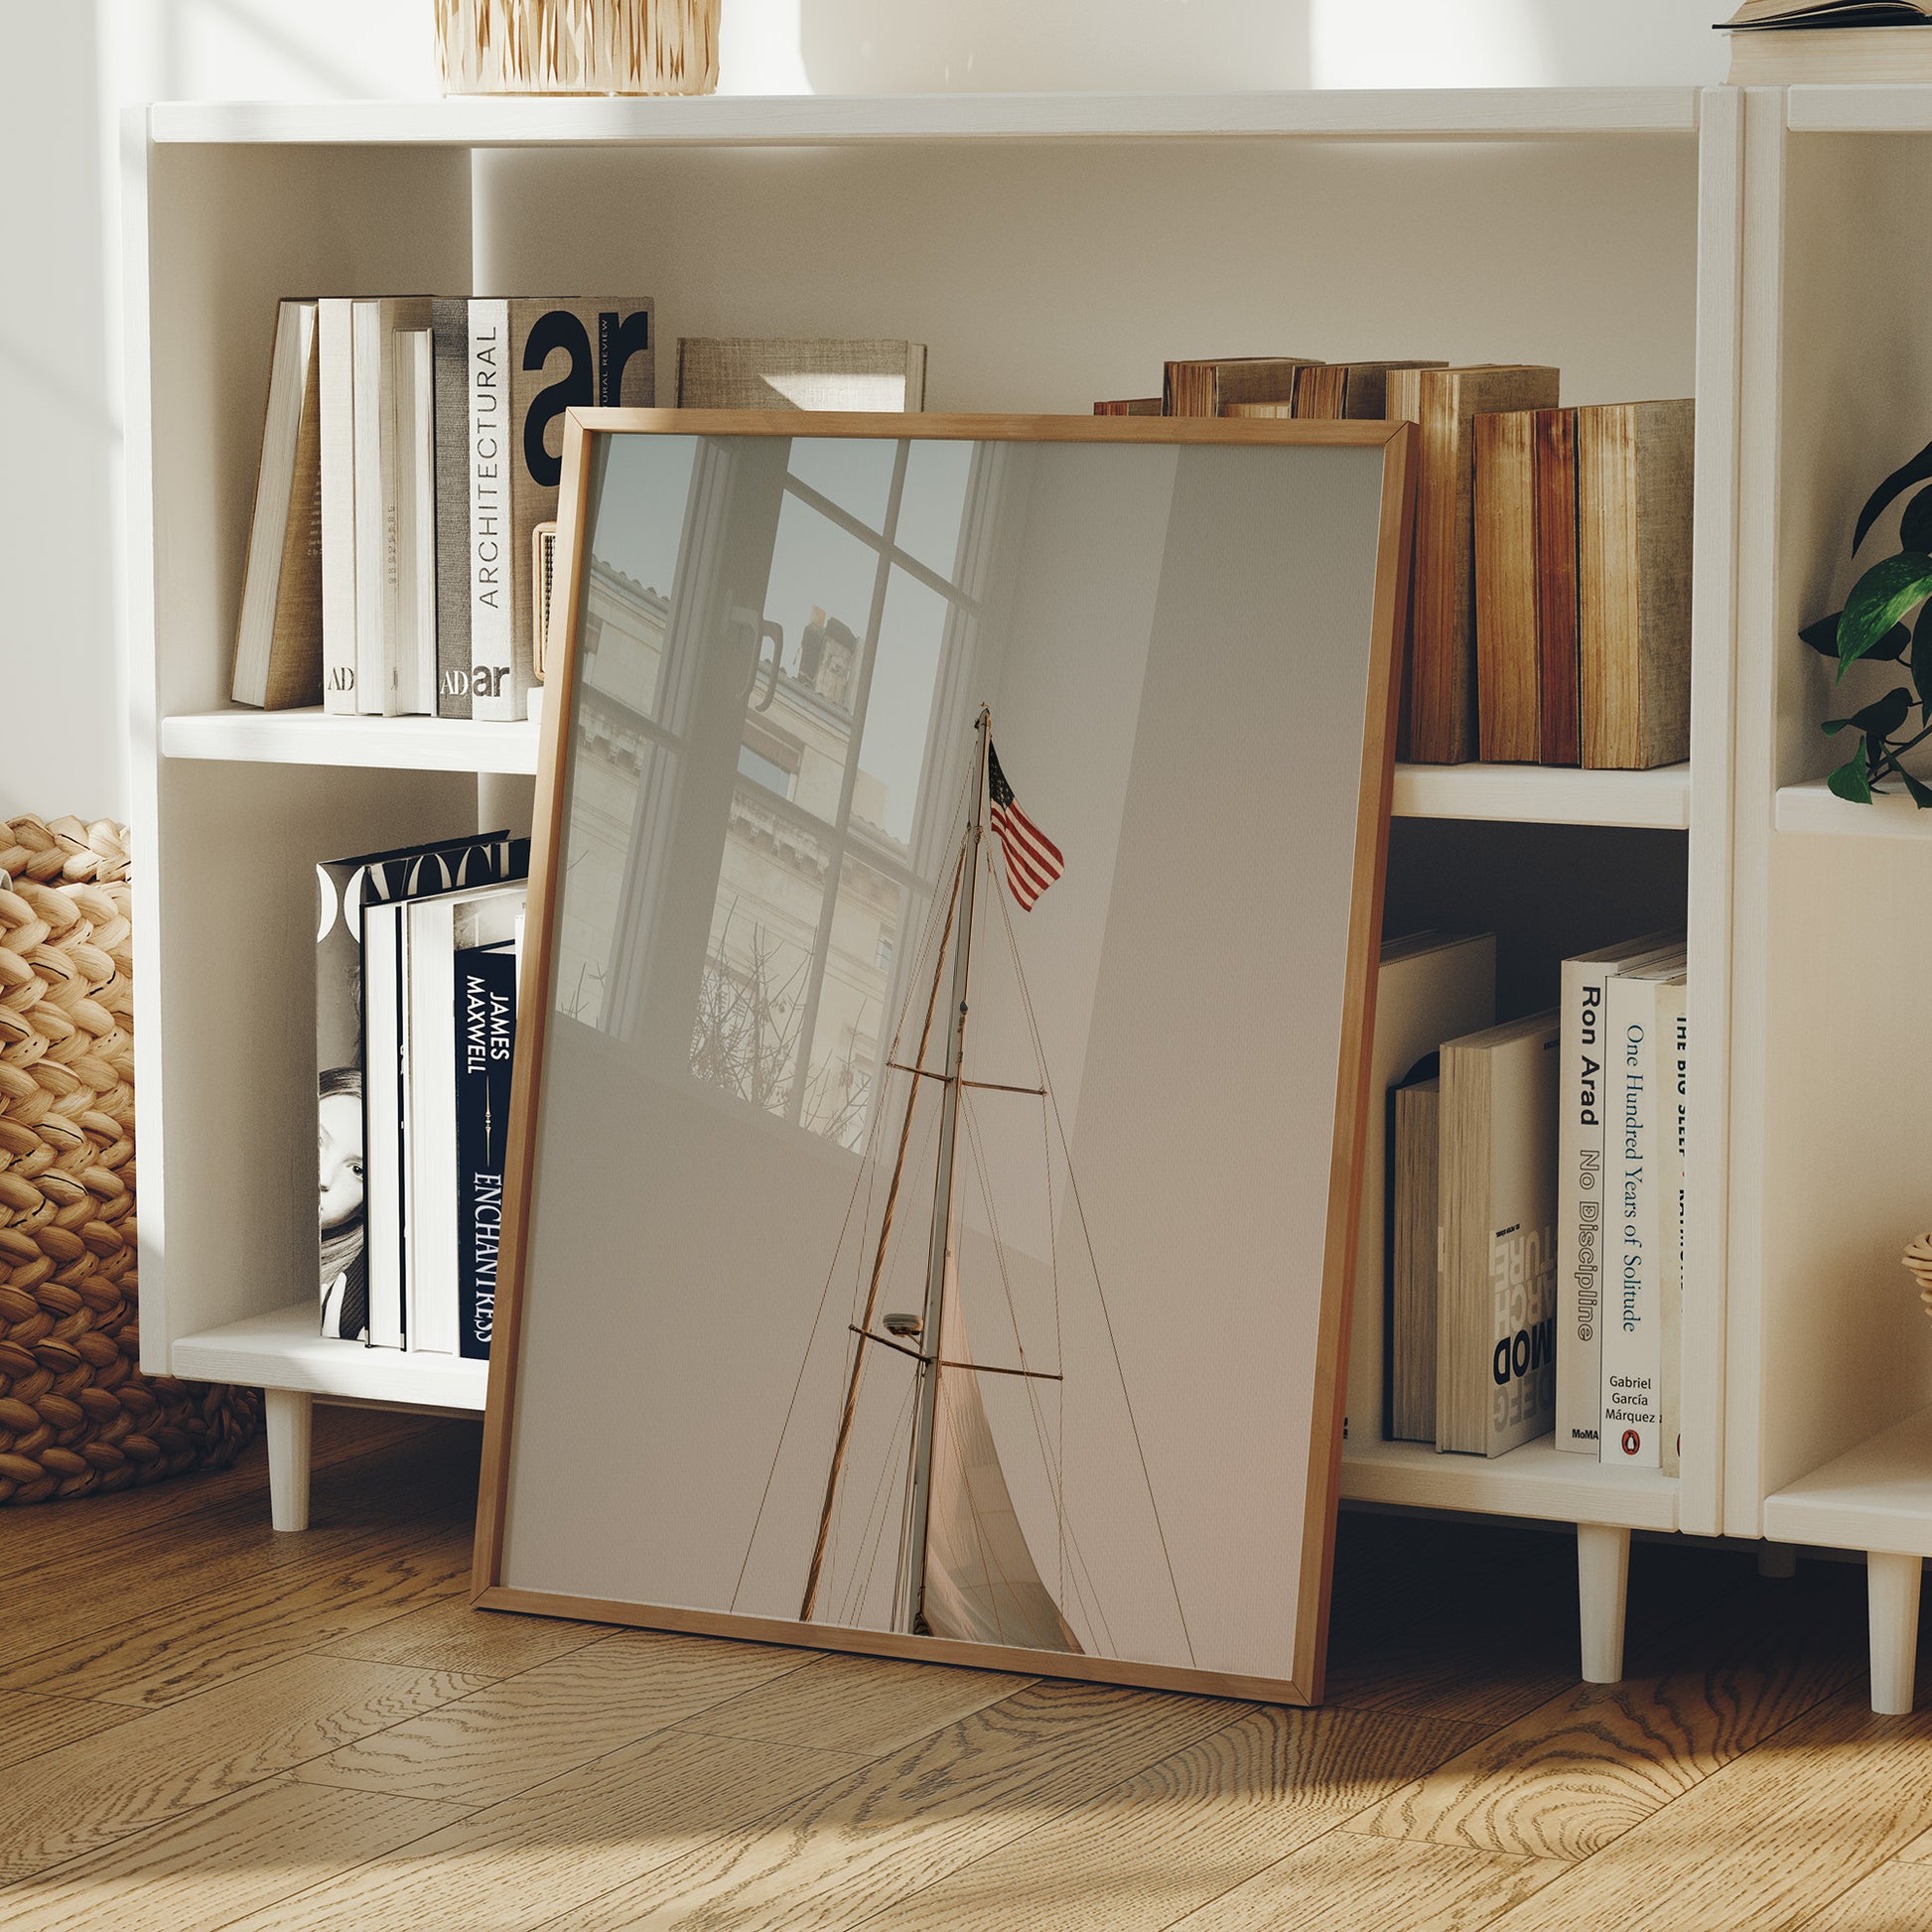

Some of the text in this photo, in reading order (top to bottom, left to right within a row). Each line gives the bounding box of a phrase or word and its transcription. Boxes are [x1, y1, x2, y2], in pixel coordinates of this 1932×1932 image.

[523, 310, 648, 487] ar
[477, 326, 498, 609] ARCHITECTURAL
[328, 667, 354, 691] AD
[440, 670, 469, 697] AD
[474, 665, 510, 697] ar
[467, 975, 486, 1074] MAXWELL
[490, 992, 510, 1060] JAMES
[1575, 986, 1600, 1341] Ron Arad No Discipline
[1622, 1025, 1644, 1332] One Hundred Years of Solitude
[1493, 1317, 1553, 1385] MOD
[1609, 1375, 1651, 1389] Gabriel
[1611, 1392, 1648, 1406] García
[1572, 1429, 1599, 1441] MoMA
[1605, 1408, 1655, 1424] Márquez
